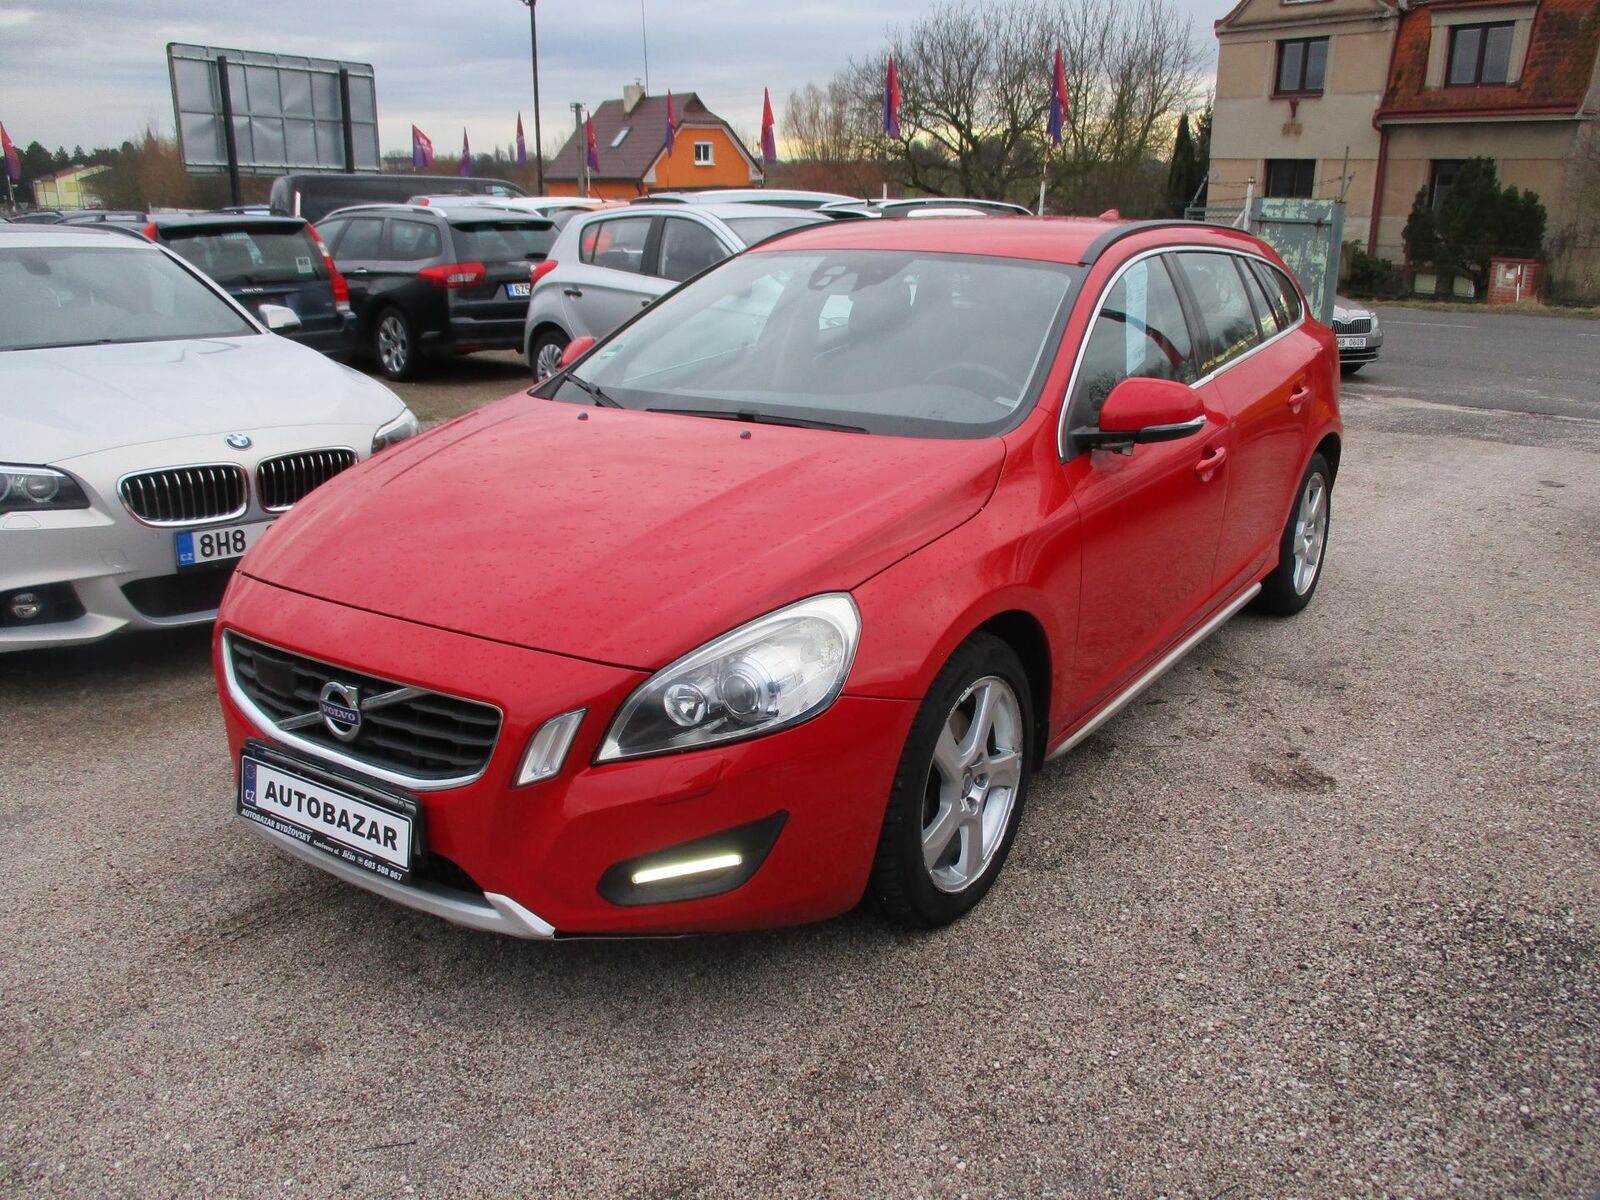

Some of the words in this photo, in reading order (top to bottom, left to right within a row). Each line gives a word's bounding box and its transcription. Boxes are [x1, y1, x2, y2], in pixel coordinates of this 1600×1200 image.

[200, 530, 246, 558] 8H8
[321, 703, 356, 722] VOLVO
[245, 788, 255, 802] CZ
[241, 808, 276, 828] AUTOBAZAR
[275, 822, 312, 843] BYDŽOVSKÝ
[264, 780, 399, 851] AUTOBAZAR
